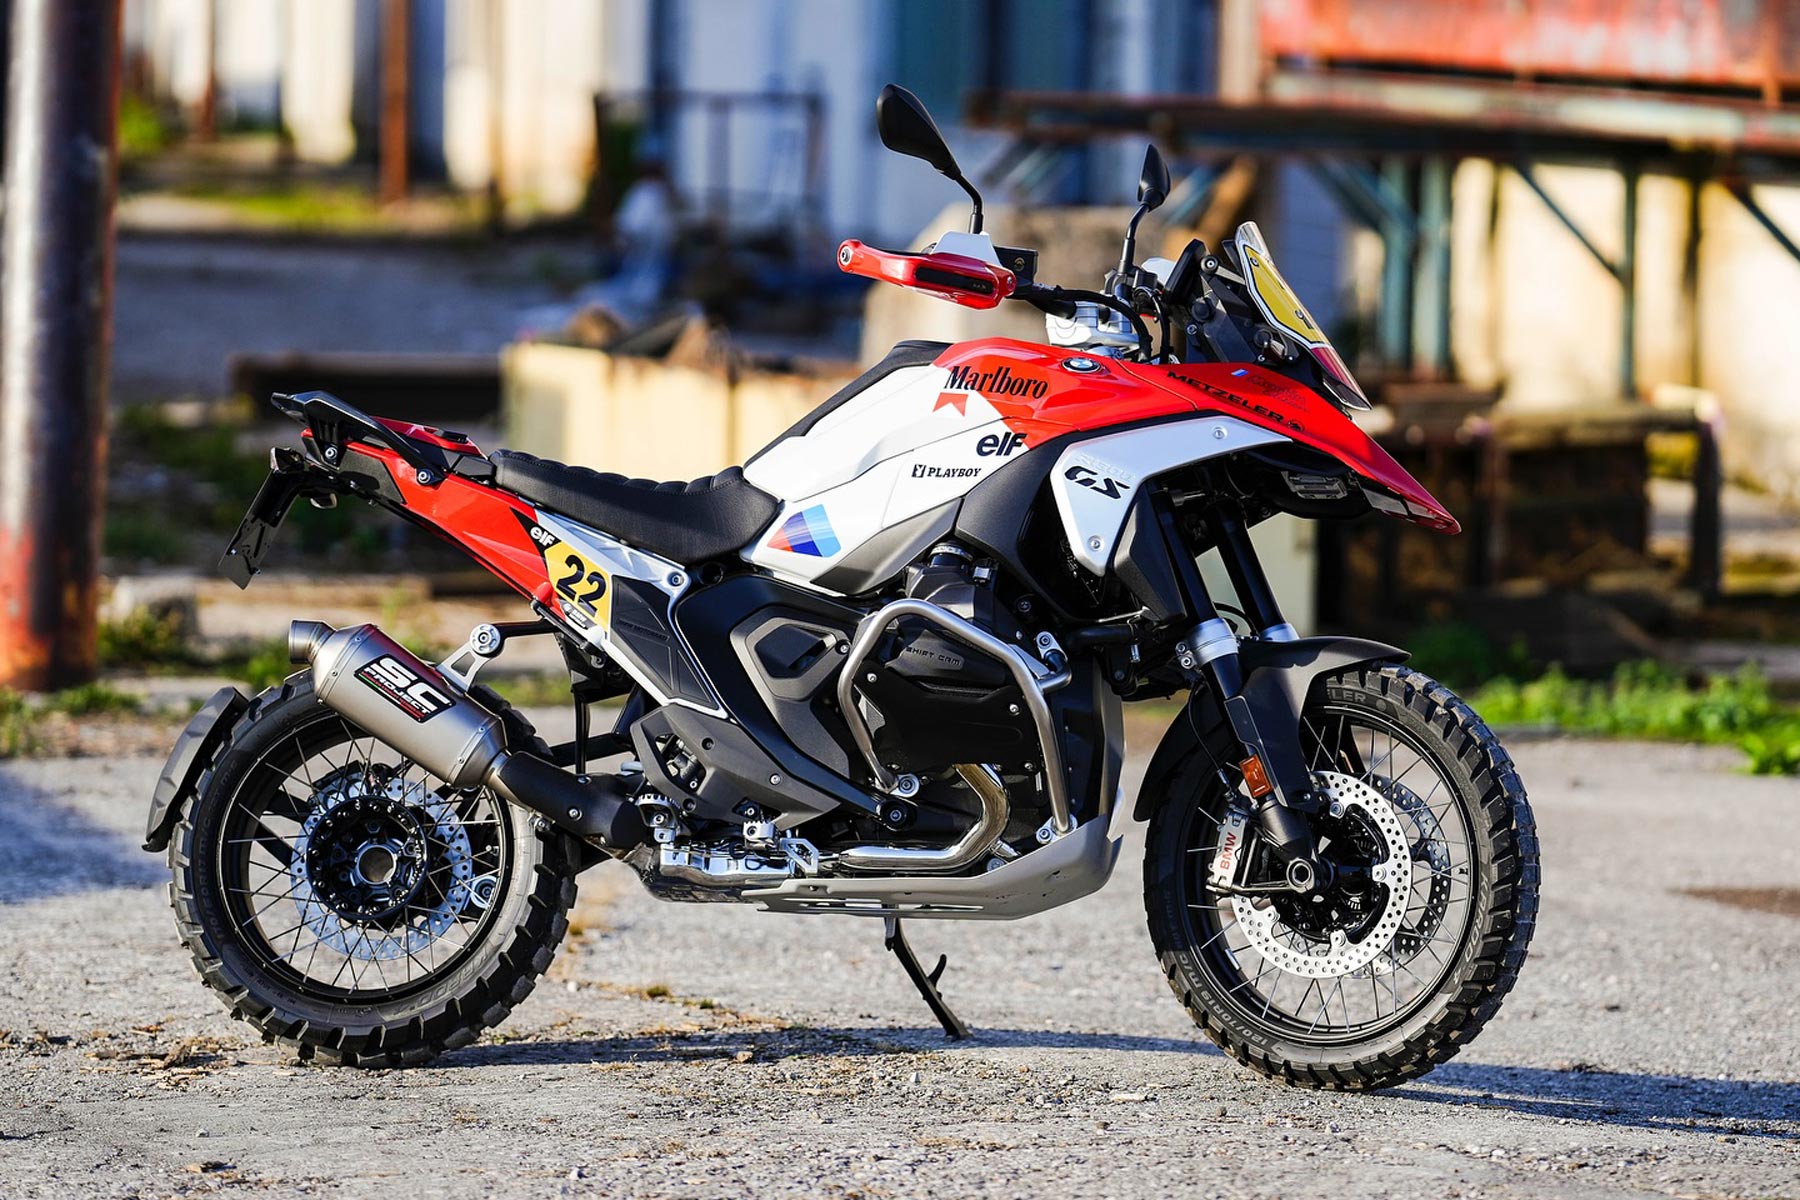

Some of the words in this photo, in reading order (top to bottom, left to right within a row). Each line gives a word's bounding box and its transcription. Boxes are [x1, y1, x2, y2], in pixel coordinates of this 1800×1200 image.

[944, 365, 1049, 399] Marlboro
[1167, 370, 1285, 423] METZELER
[976, 431, 1027, 457] elf
[927, 467, 982, 478] PLAYBOY
[1064, 465, 1131, 500] GS
[530, 526, 556, 547] elf
[556, 554, 606, 617] 22
[364, 667, 431, 714] PROJECT
[370, 656, 451, 712] SC
[1220, 832, 1237, 870] BMW
[1200, 989, 1268, 1045] 120/70R19
